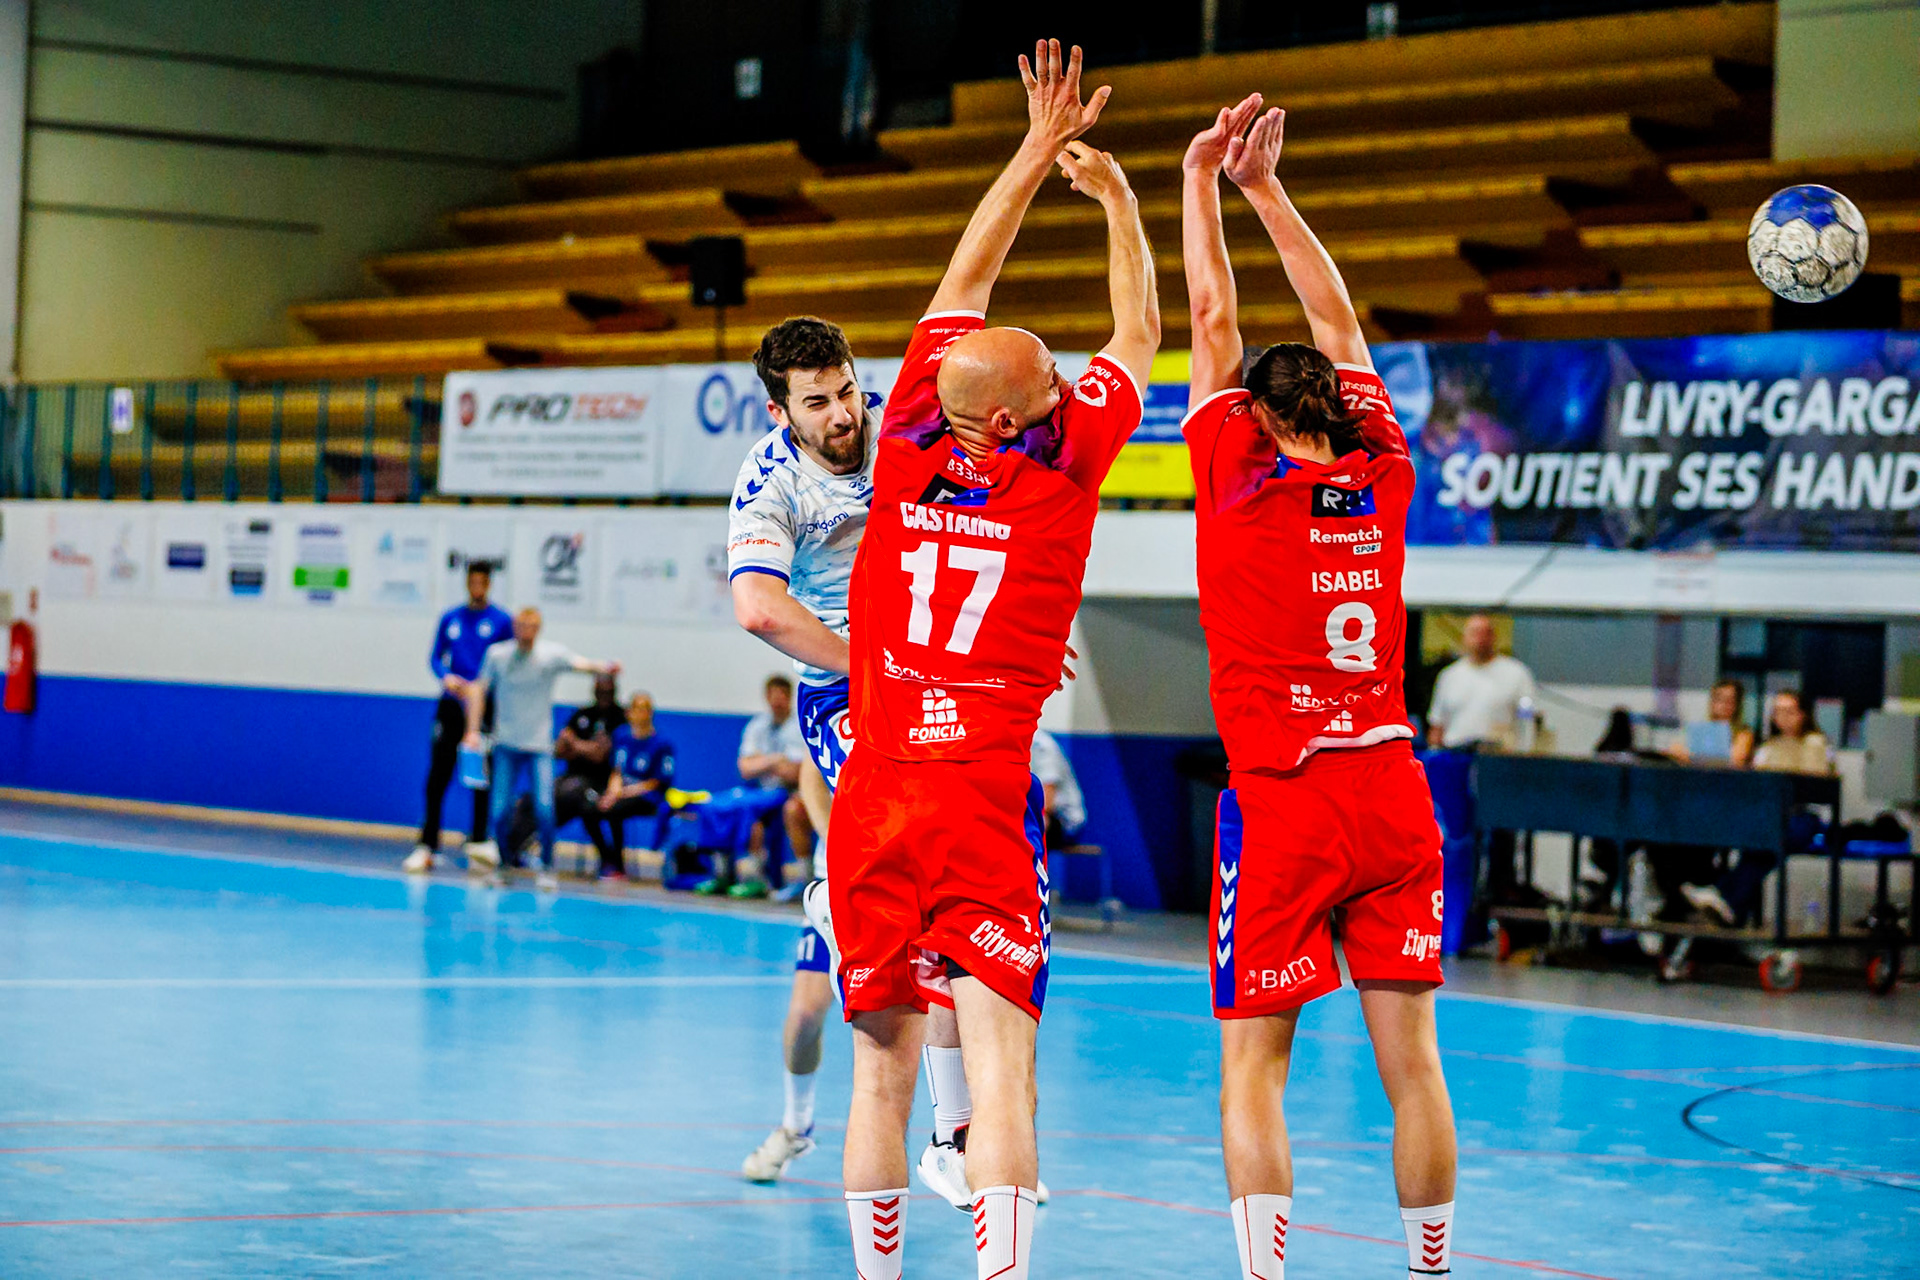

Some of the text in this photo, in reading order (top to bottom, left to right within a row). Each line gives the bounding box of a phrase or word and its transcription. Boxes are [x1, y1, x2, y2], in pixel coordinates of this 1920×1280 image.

[1437, 452, 1671, 510] SOUTIENT
[1672, 452, 1764, 510] SES
[1310, 525, 1382, 543] Rematch
[1312, 569, 1383, 592] ISABEL
[901, 541, 1007, 655] 17
[1325, 602, 1377, 672] 8
[909, 725, 966, 740] FONCIA
[1430, 890, 1444, 922] 8
